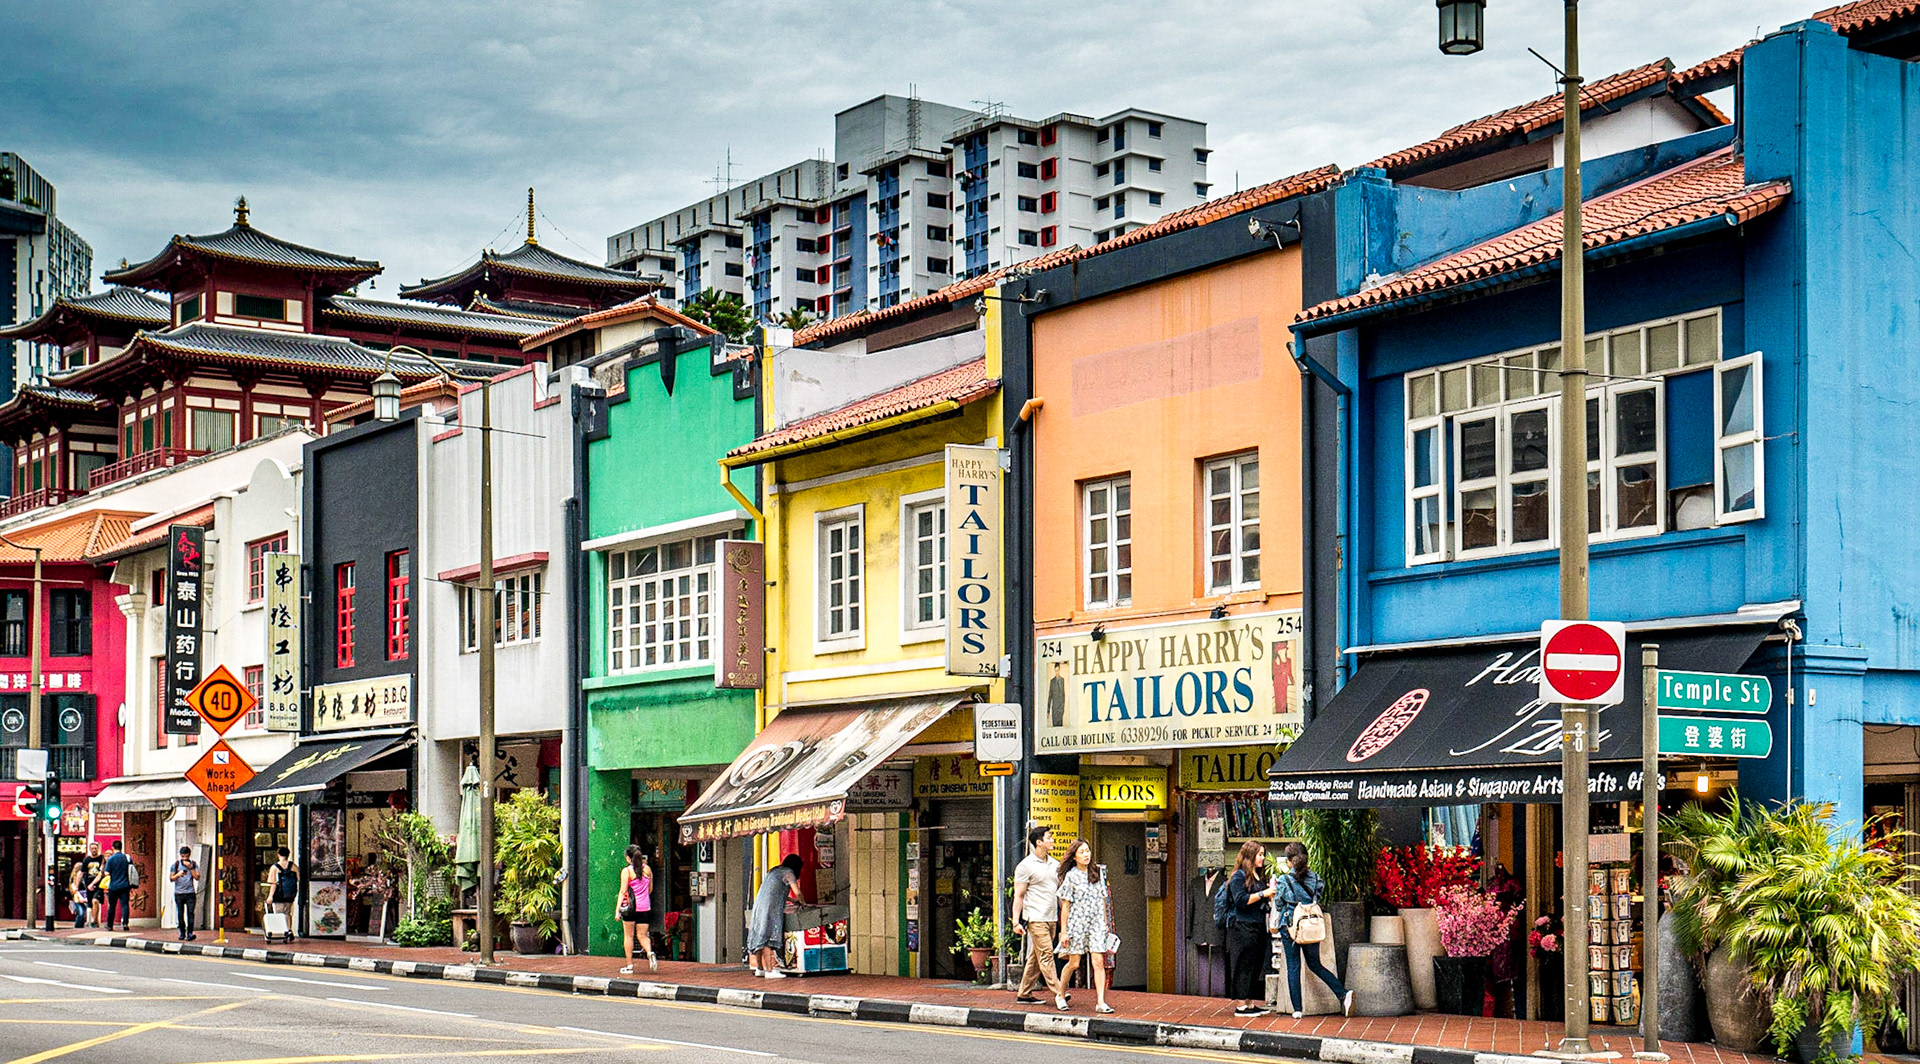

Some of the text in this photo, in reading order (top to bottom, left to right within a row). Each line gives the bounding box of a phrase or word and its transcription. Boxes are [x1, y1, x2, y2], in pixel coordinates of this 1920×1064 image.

[952, 459, 984, 470] HAPPY
[958, 469, 997, 480] HARRY'S
[957, 484, 991, 654] TAILORS
[175, 581, 197, 680] 泰山药行
[1277, 616, 1303, 634] 254
[1041, 641, 1063, 658] 254
[1072, 624, 1264, 676] HAPPY HARRY'S
[978, 662, 997, 674] 254
[175, 688, 191, 696] Thy
[383, 685, 408, 704] B.B.Q
[1083, 666, 1254, 723] TAILORS
[1663, 675, 1760, 705] Temple St
[211, 691, 231, 710] 40
[269, 702, 298, 712] B.B.Q
[169, 708, 199, 716] Medica
[981, 719, 1017, 728] PEDESTRIANS
[981, 731, 1017, 740] Use Crossing
[1041, 736, 1060, 748] CALL
[1062, 735, 1078, 746] OUR
[1081, 732, 1115, 745] HOTLINE
[1121, 725, 1169, 743] 63389296
[1172, 728, 1188, 741] FOR
[1192, 726, 1221, 739] PICKUP
[1225, 725, 1259, 738] SERVICE
[1263, 724, 1272, 736] 24
[1684, 725, 1747, 749] 登婆街
[206, 769, 236, 779] Works
[1192, 751, 1281, 783] TAILO
[206, 782, 236, 792] Ahead
[941, 782, 968, 794] GINSENG
[1031, 778, 1049, 786] READY
[1057, 779, 1068, 787] ONE
[1269, 779, 1354, 792] 252 South Bridge Road
[1358, 771, 1666, 799] Handmade Asian & Singapore Arts afts Gis
[1034, 788, 1050, 796] MADE
[1079, 784, 1155, 801] TAILORS
